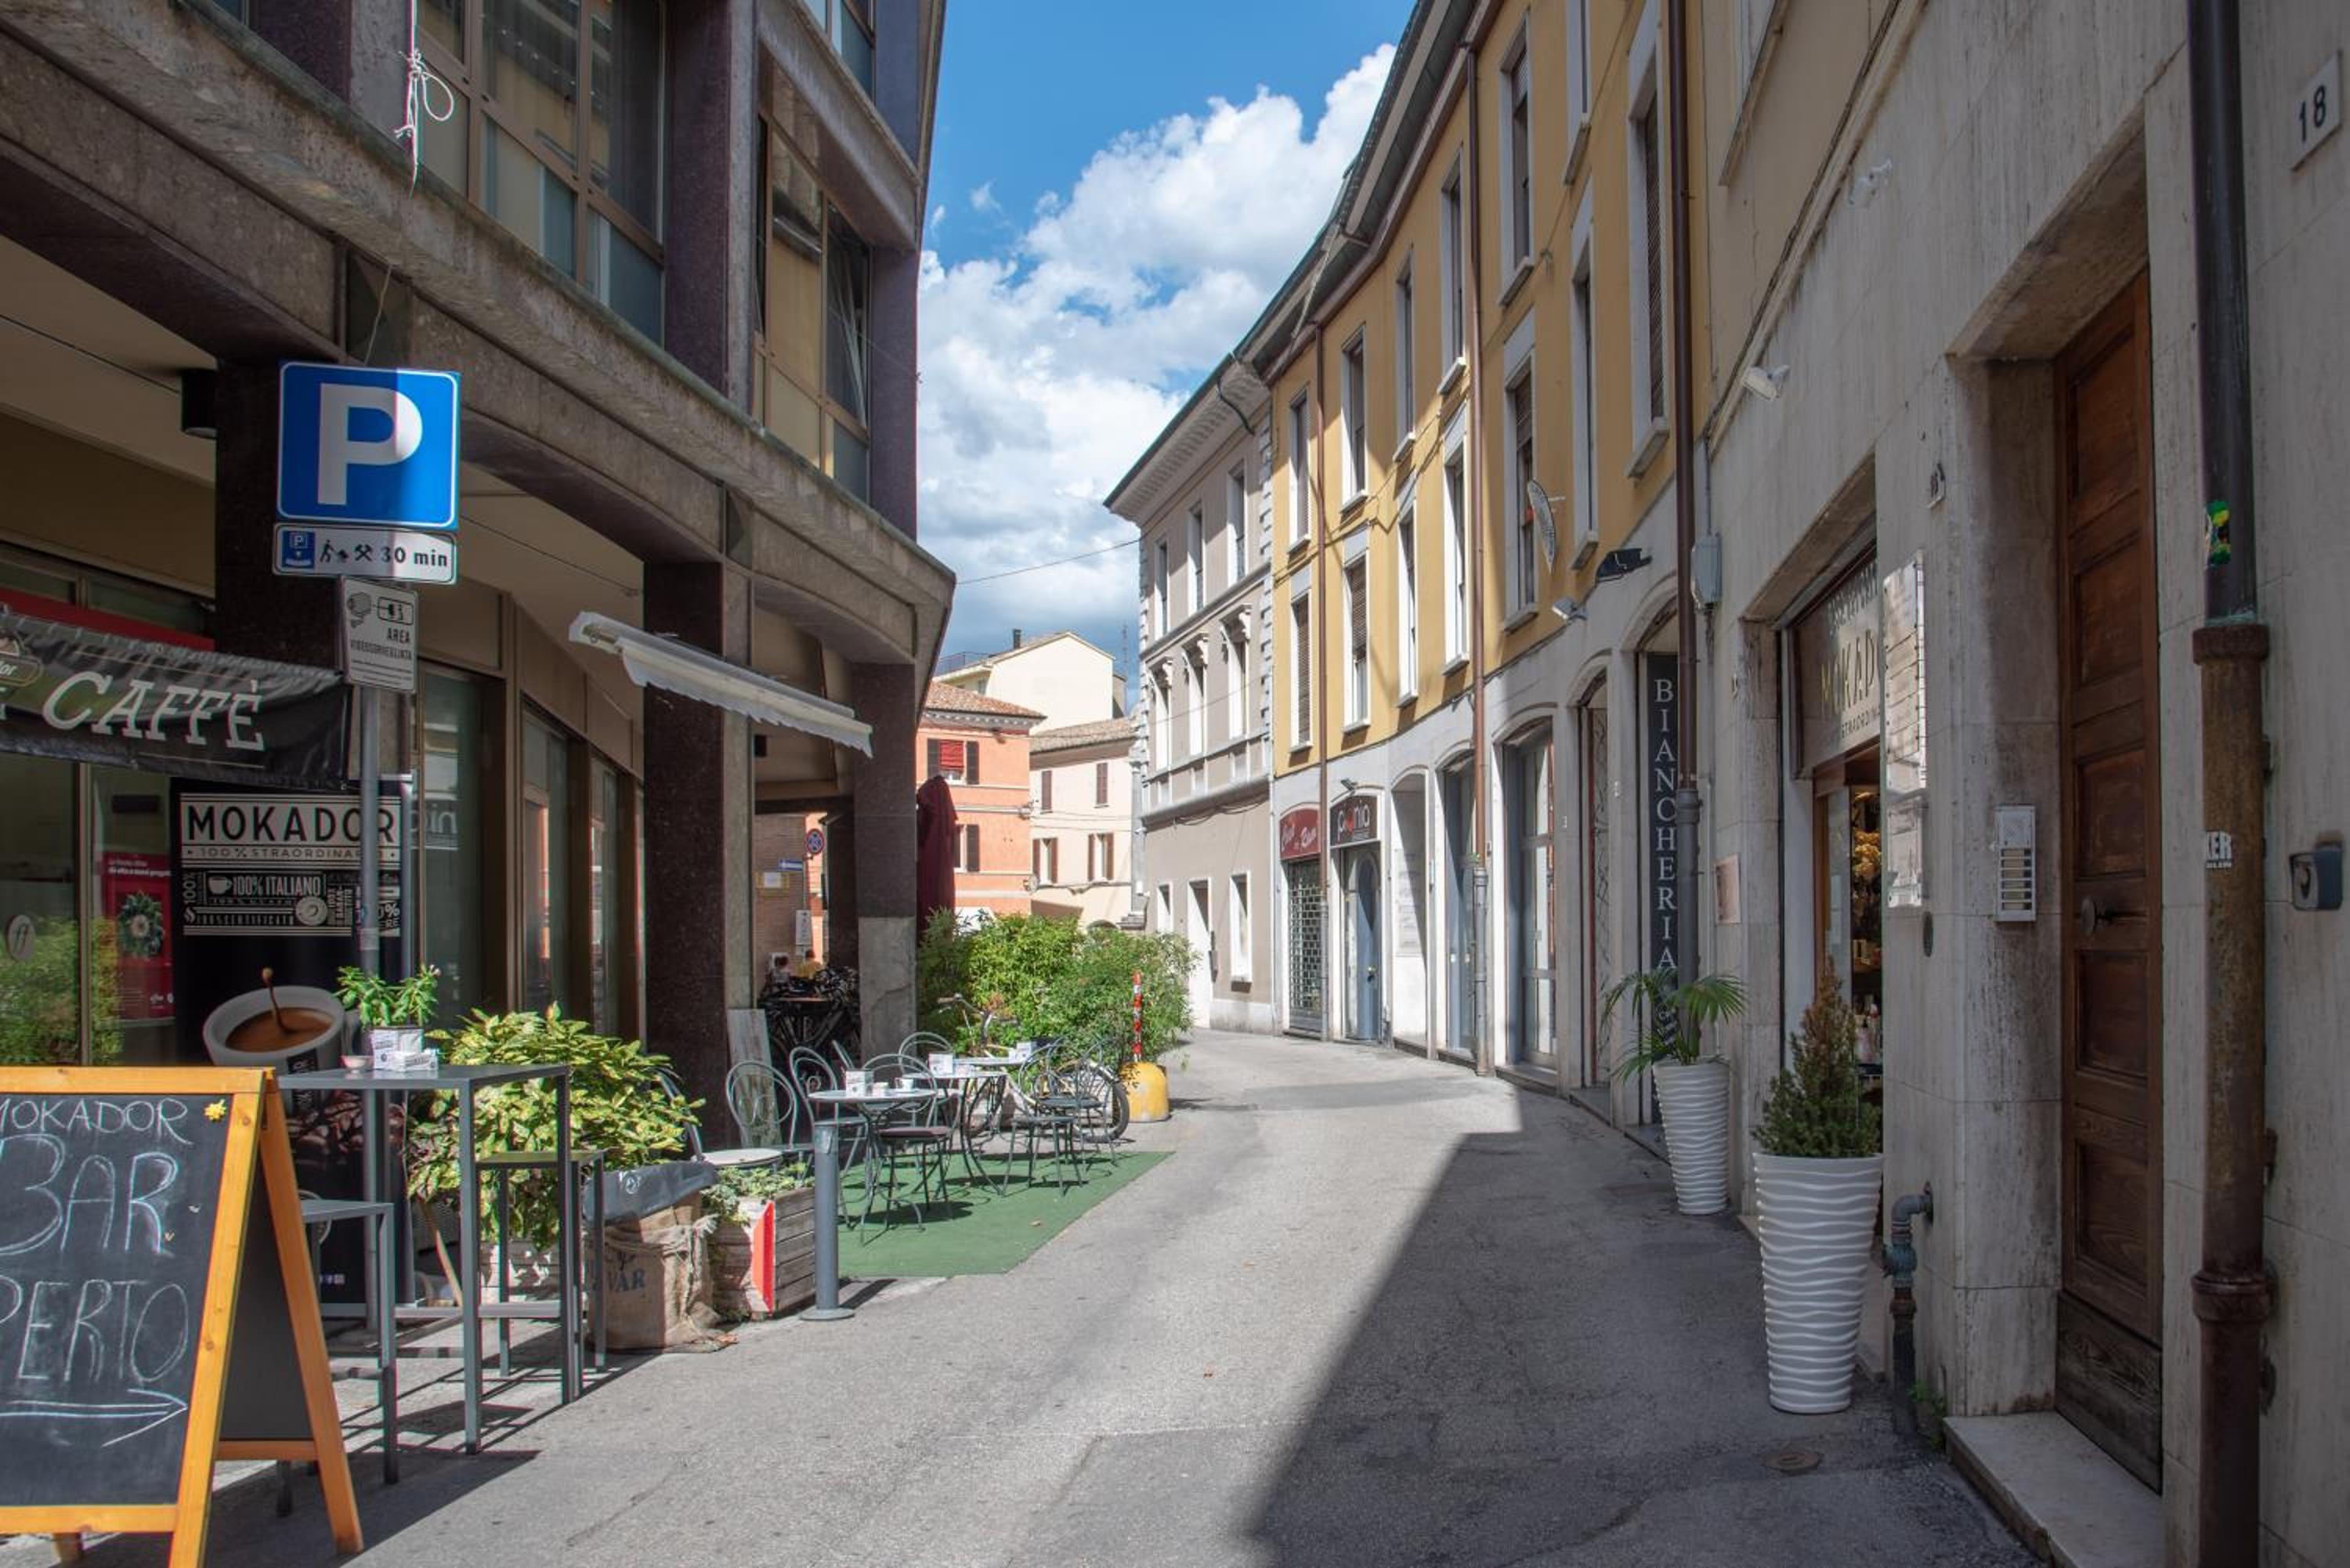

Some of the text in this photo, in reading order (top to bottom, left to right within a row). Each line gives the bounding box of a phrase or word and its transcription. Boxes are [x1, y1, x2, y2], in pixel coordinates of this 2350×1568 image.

[2298, 84, 2326, 143] 18
[317, 382, 423, 506] P
[294, 535, 304, 545] P
[381, 547, 448, 567] 30 min
[386, 627, 411, 643] AREA
[1820, 629, 1880, 716] MOKAD
[42, 670, 265, 752] CAFFÈ
[187, 806, 396, 842] MOKADOR
[1654, 678, 1677, 970] BIANCHERIA
[201, 848, 248, 858] 100%
[233, 876, 263, 896] 100%
[266, 876, 321, 896] ITALIANO
[0, 1133, 179, 1256] BAR
